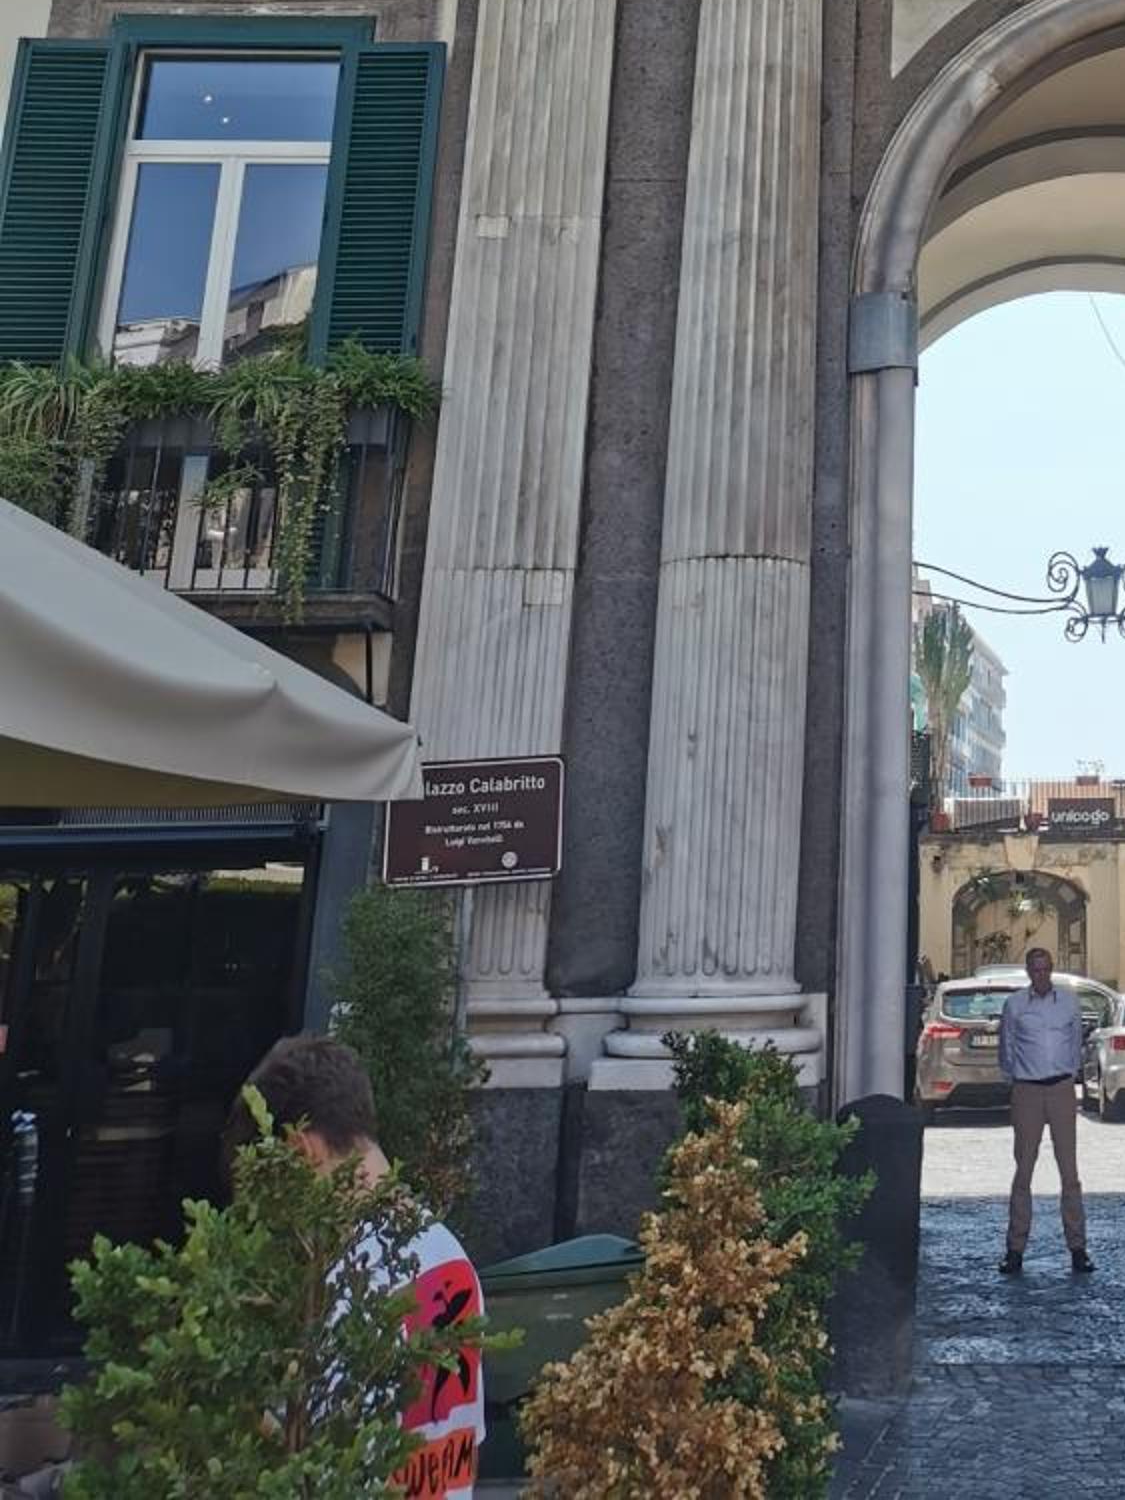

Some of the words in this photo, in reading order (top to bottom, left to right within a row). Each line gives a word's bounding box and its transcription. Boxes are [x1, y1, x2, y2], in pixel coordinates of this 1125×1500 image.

[426, 779, 465, 796] lazzo
[470, 776, 545, 793] Calabritto
[473, 803, 499, 813] XVIII
